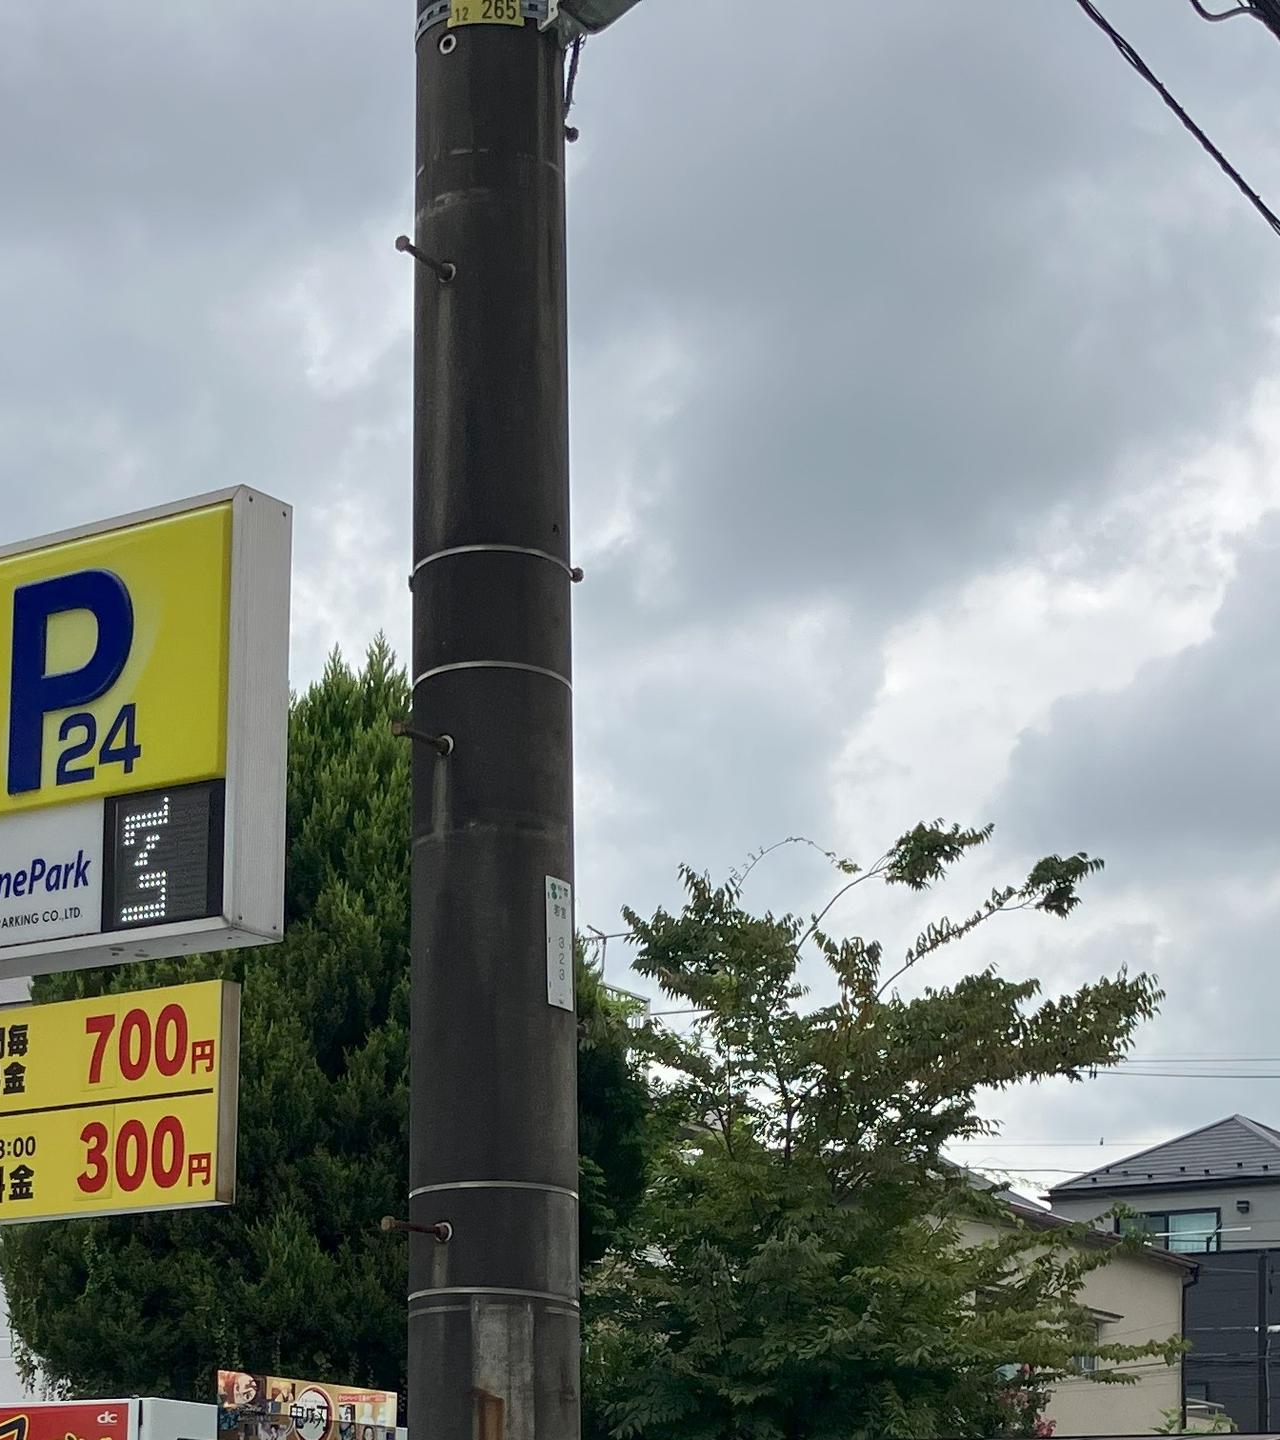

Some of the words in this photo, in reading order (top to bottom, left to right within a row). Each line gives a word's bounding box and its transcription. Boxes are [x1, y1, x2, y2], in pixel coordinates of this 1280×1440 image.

[455, 7, 469, 21] 12
[480, 0, 516, 20] 265
[8, 568, 133, 796] P
[56, 703, 141, 786] 24
